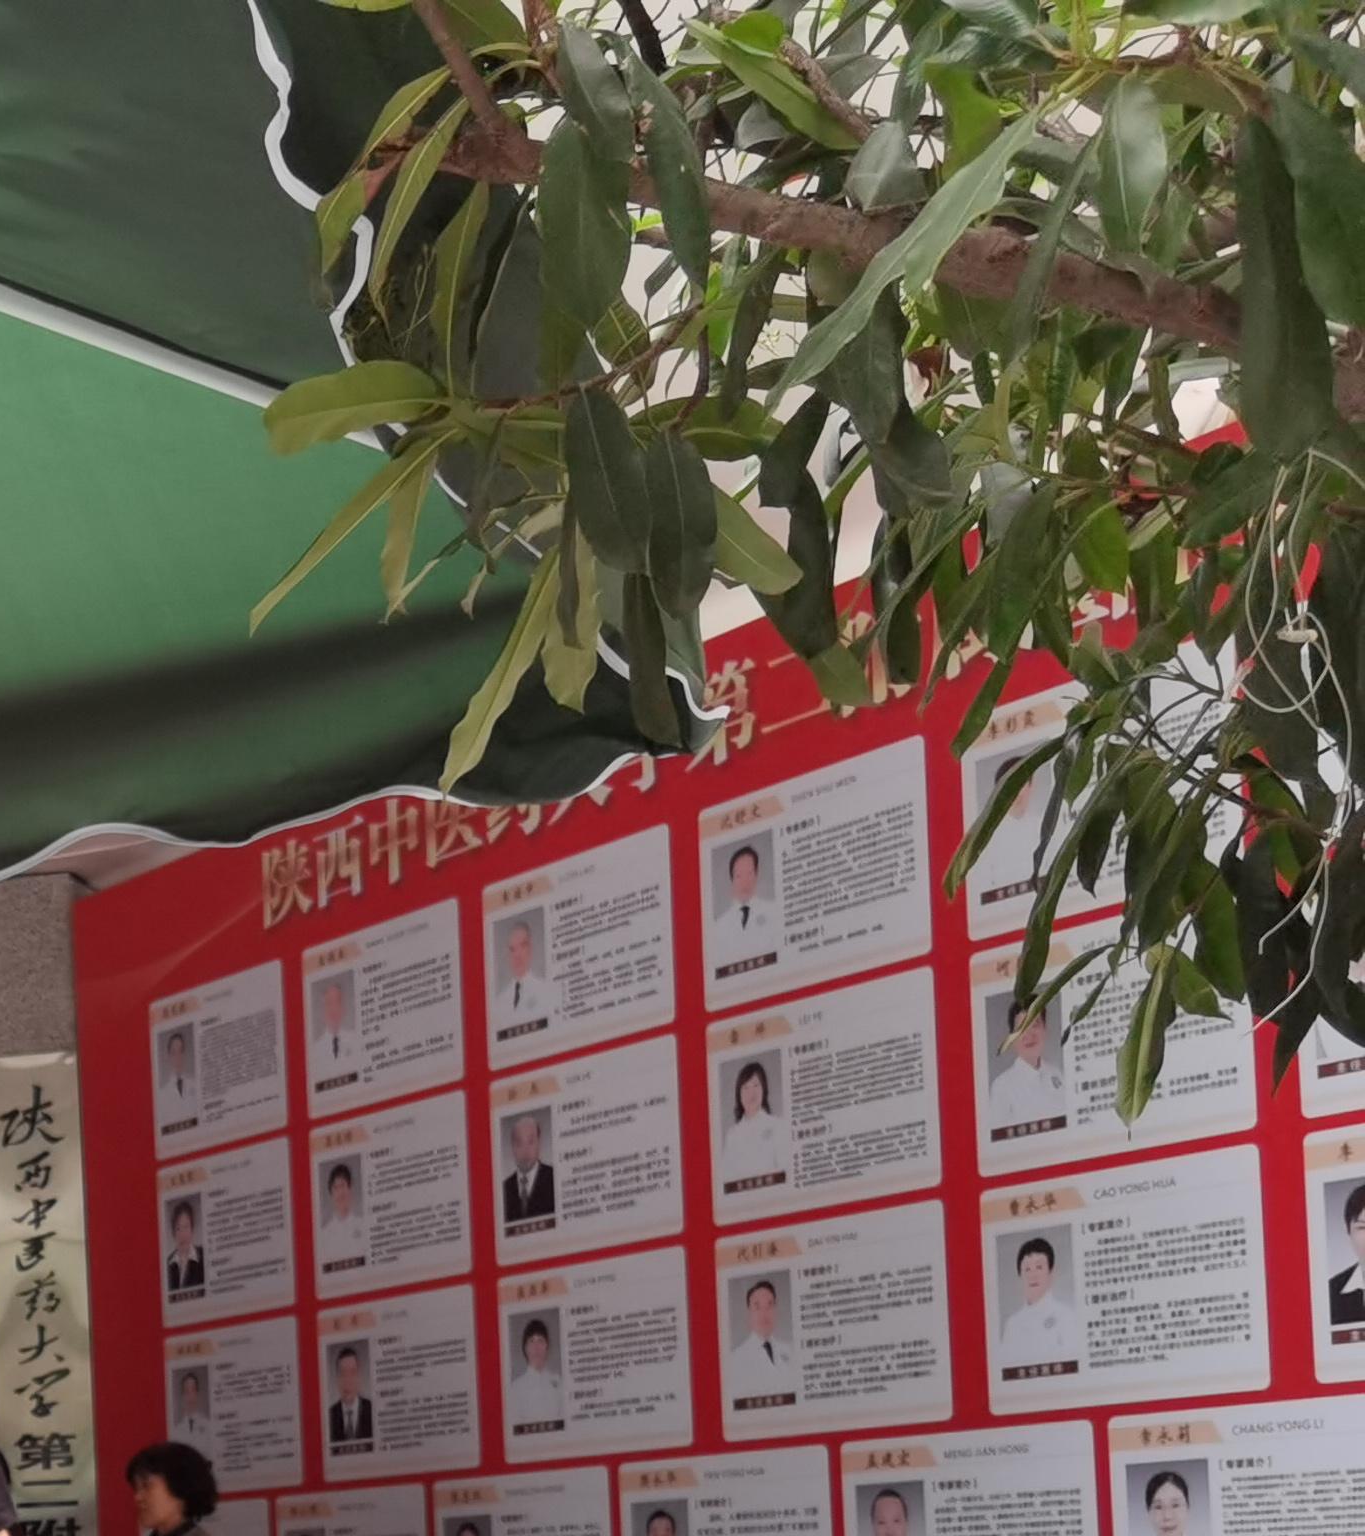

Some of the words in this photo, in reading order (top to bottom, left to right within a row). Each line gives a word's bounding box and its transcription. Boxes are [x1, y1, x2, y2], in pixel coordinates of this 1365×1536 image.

[1093, 1188, 1117, 1200] CAO
[1232, 1424, 1273, 1436] CHANG
[1277, 1421, 1311, 1434] YONG
